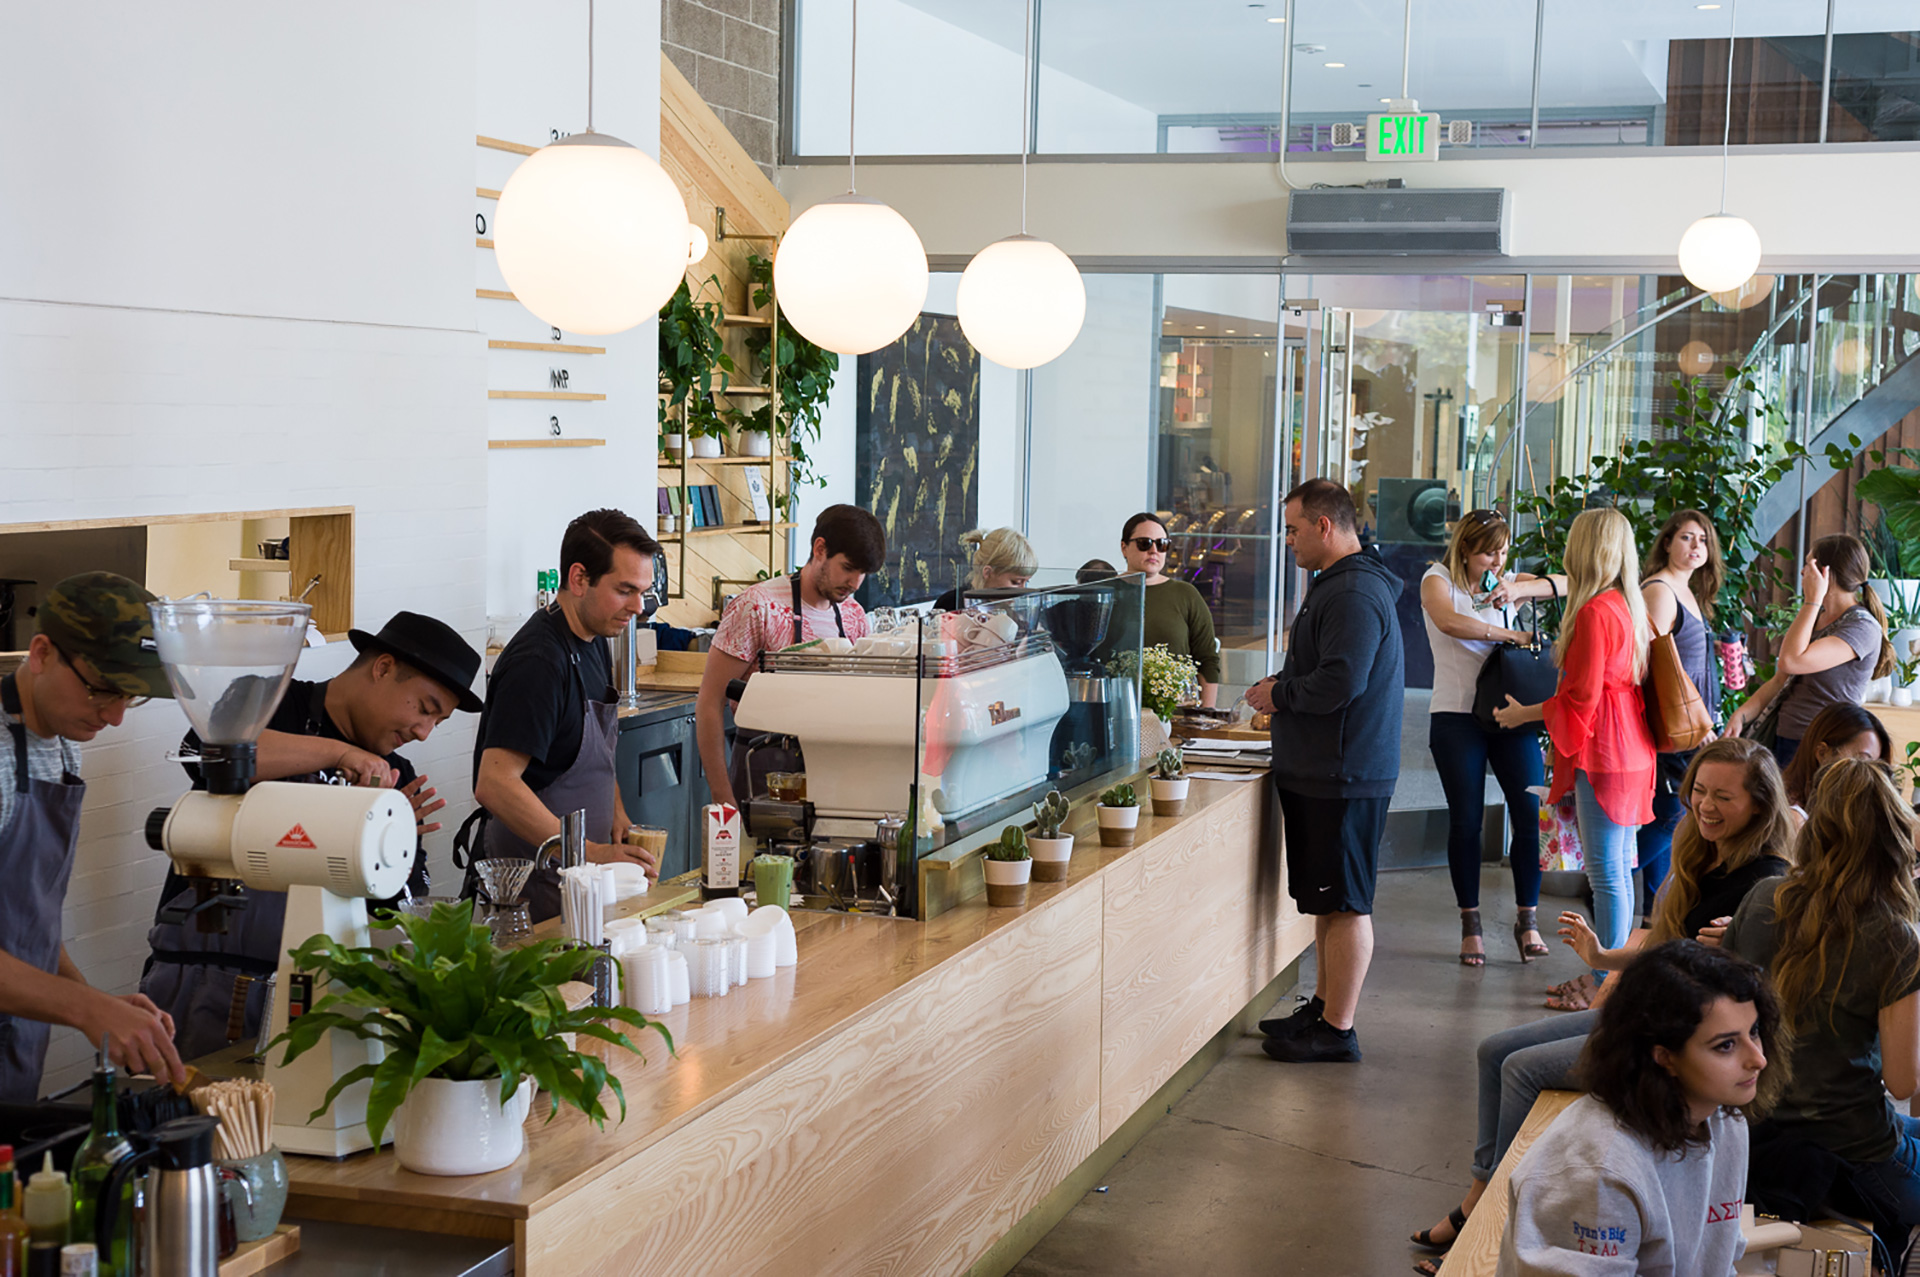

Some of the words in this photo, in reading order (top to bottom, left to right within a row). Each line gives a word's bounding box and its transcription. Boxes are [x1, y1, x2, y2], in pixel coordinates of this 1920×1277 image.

[1378, 116, 1429, 154] EXIT
[1573, 1221, 1606, 1240] Ryan's
[1608, 1226, 1626, 1244] Big
